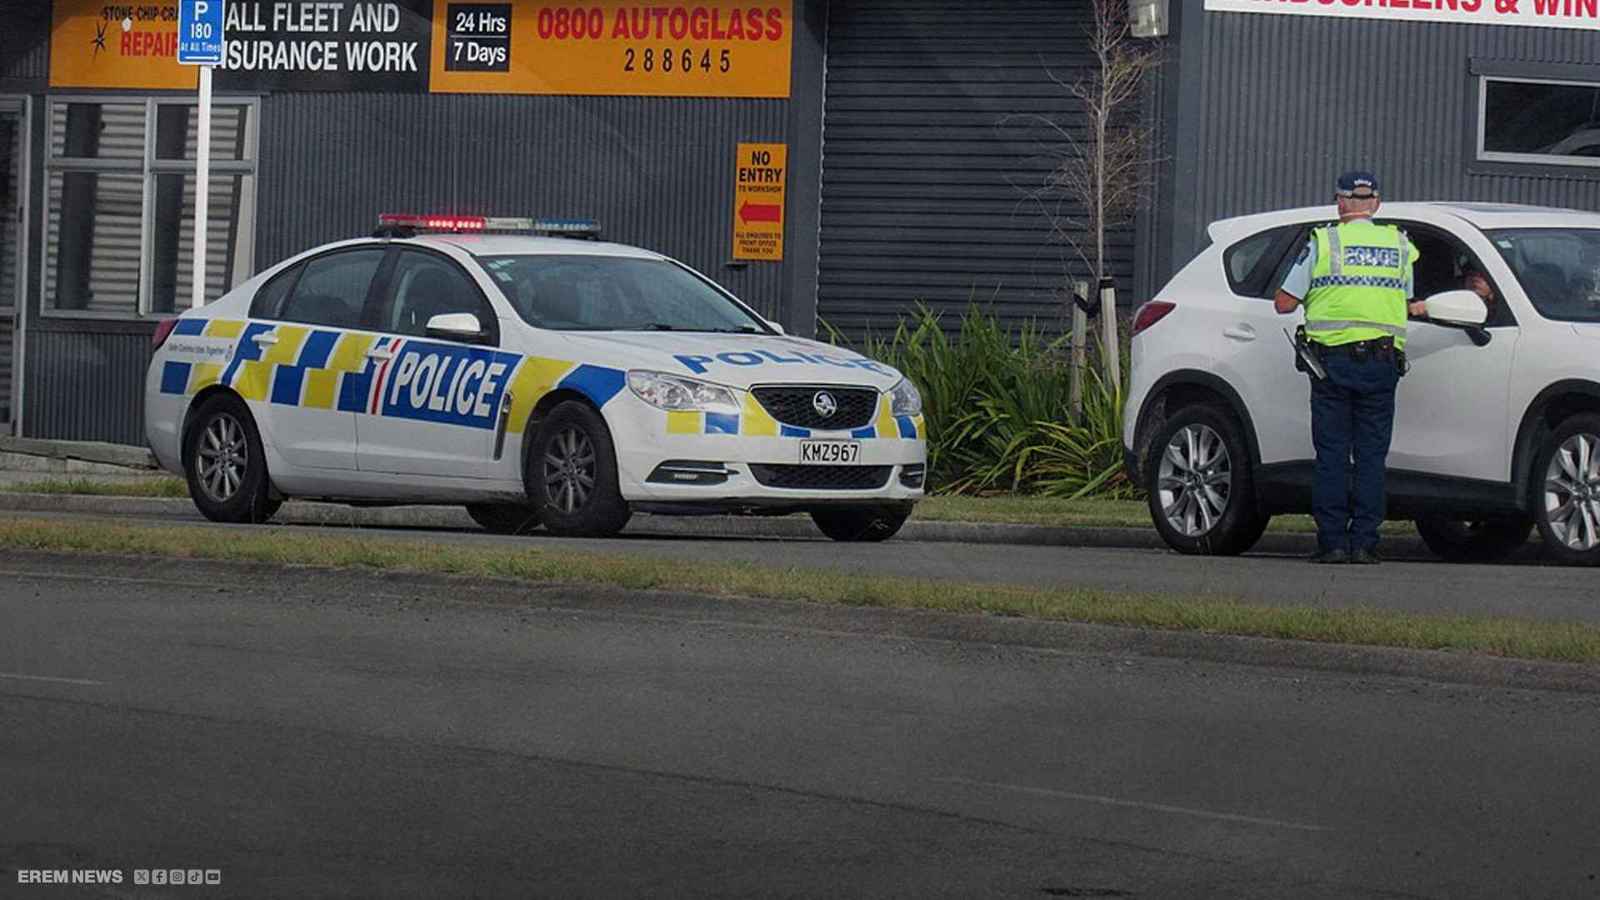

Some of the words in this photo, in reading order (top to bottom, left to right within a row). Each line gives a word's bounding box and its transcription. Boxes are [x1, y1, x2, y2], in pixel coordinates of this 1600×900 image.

[195, 1, 208, 21] P
[225, 3, 266, 32] ALL
[273, 3, 344, 33] FLEET
[349, 3, 400, 33] AND
[191, 23, 212, 39] 180
[456, 12, 475, 33] 24
[478, 12, 506, 33] Hrs
[536, 8, 604, 40] 0800
[611, 7, 783, 42] AUTOGLASS
[345, 41, 418, 72] WORK
[454, 42, 461, 61] 7
[468, 43, 506, 66] Days
[752, 151, 771, 166] NO
[739, 168, 783, 183] ENTRY
[672, 350, 893, 378] POLICE
[389, 351, 507, 417] POLICE
[802, 443, 858, 462] KMZ967
